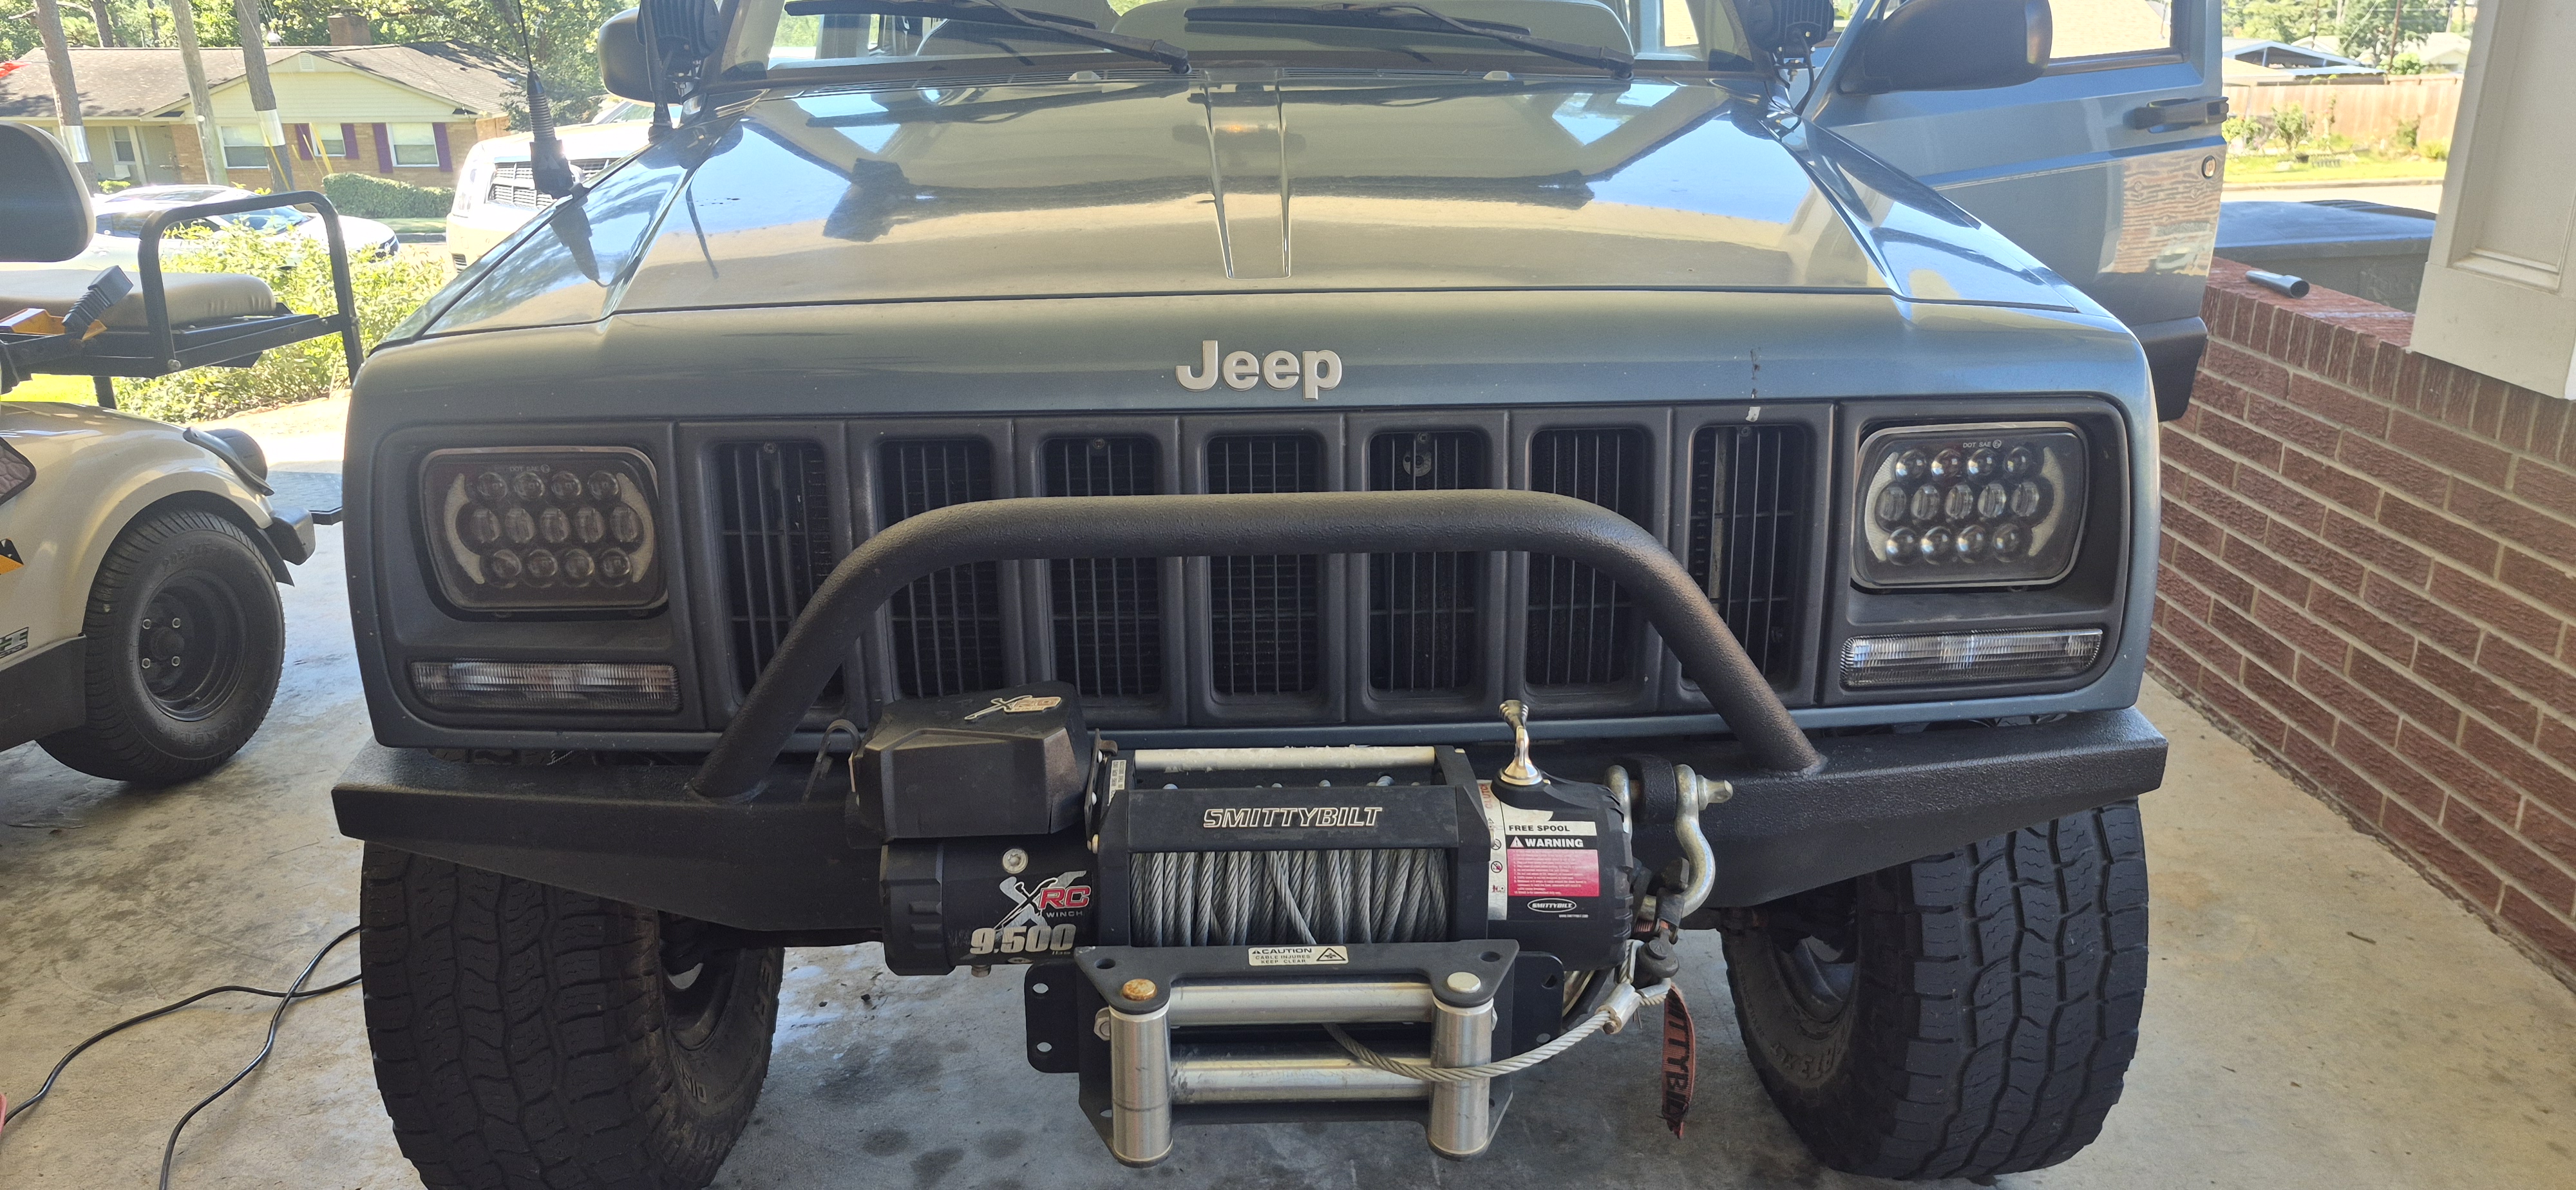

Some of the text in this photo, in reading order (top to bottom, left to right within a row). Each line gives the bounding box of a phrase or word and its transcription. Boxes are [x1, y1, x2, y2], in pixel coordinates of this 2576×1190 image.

[1175, 340, 1343, 401] Jeep
[1203, 807, 1383, 828] SMITTYBILT
[1525, 838, 1584, 847] WARNING
[994, 871, 1092, 930] XRC
[1046, 910, 1083, 918] WINCH
